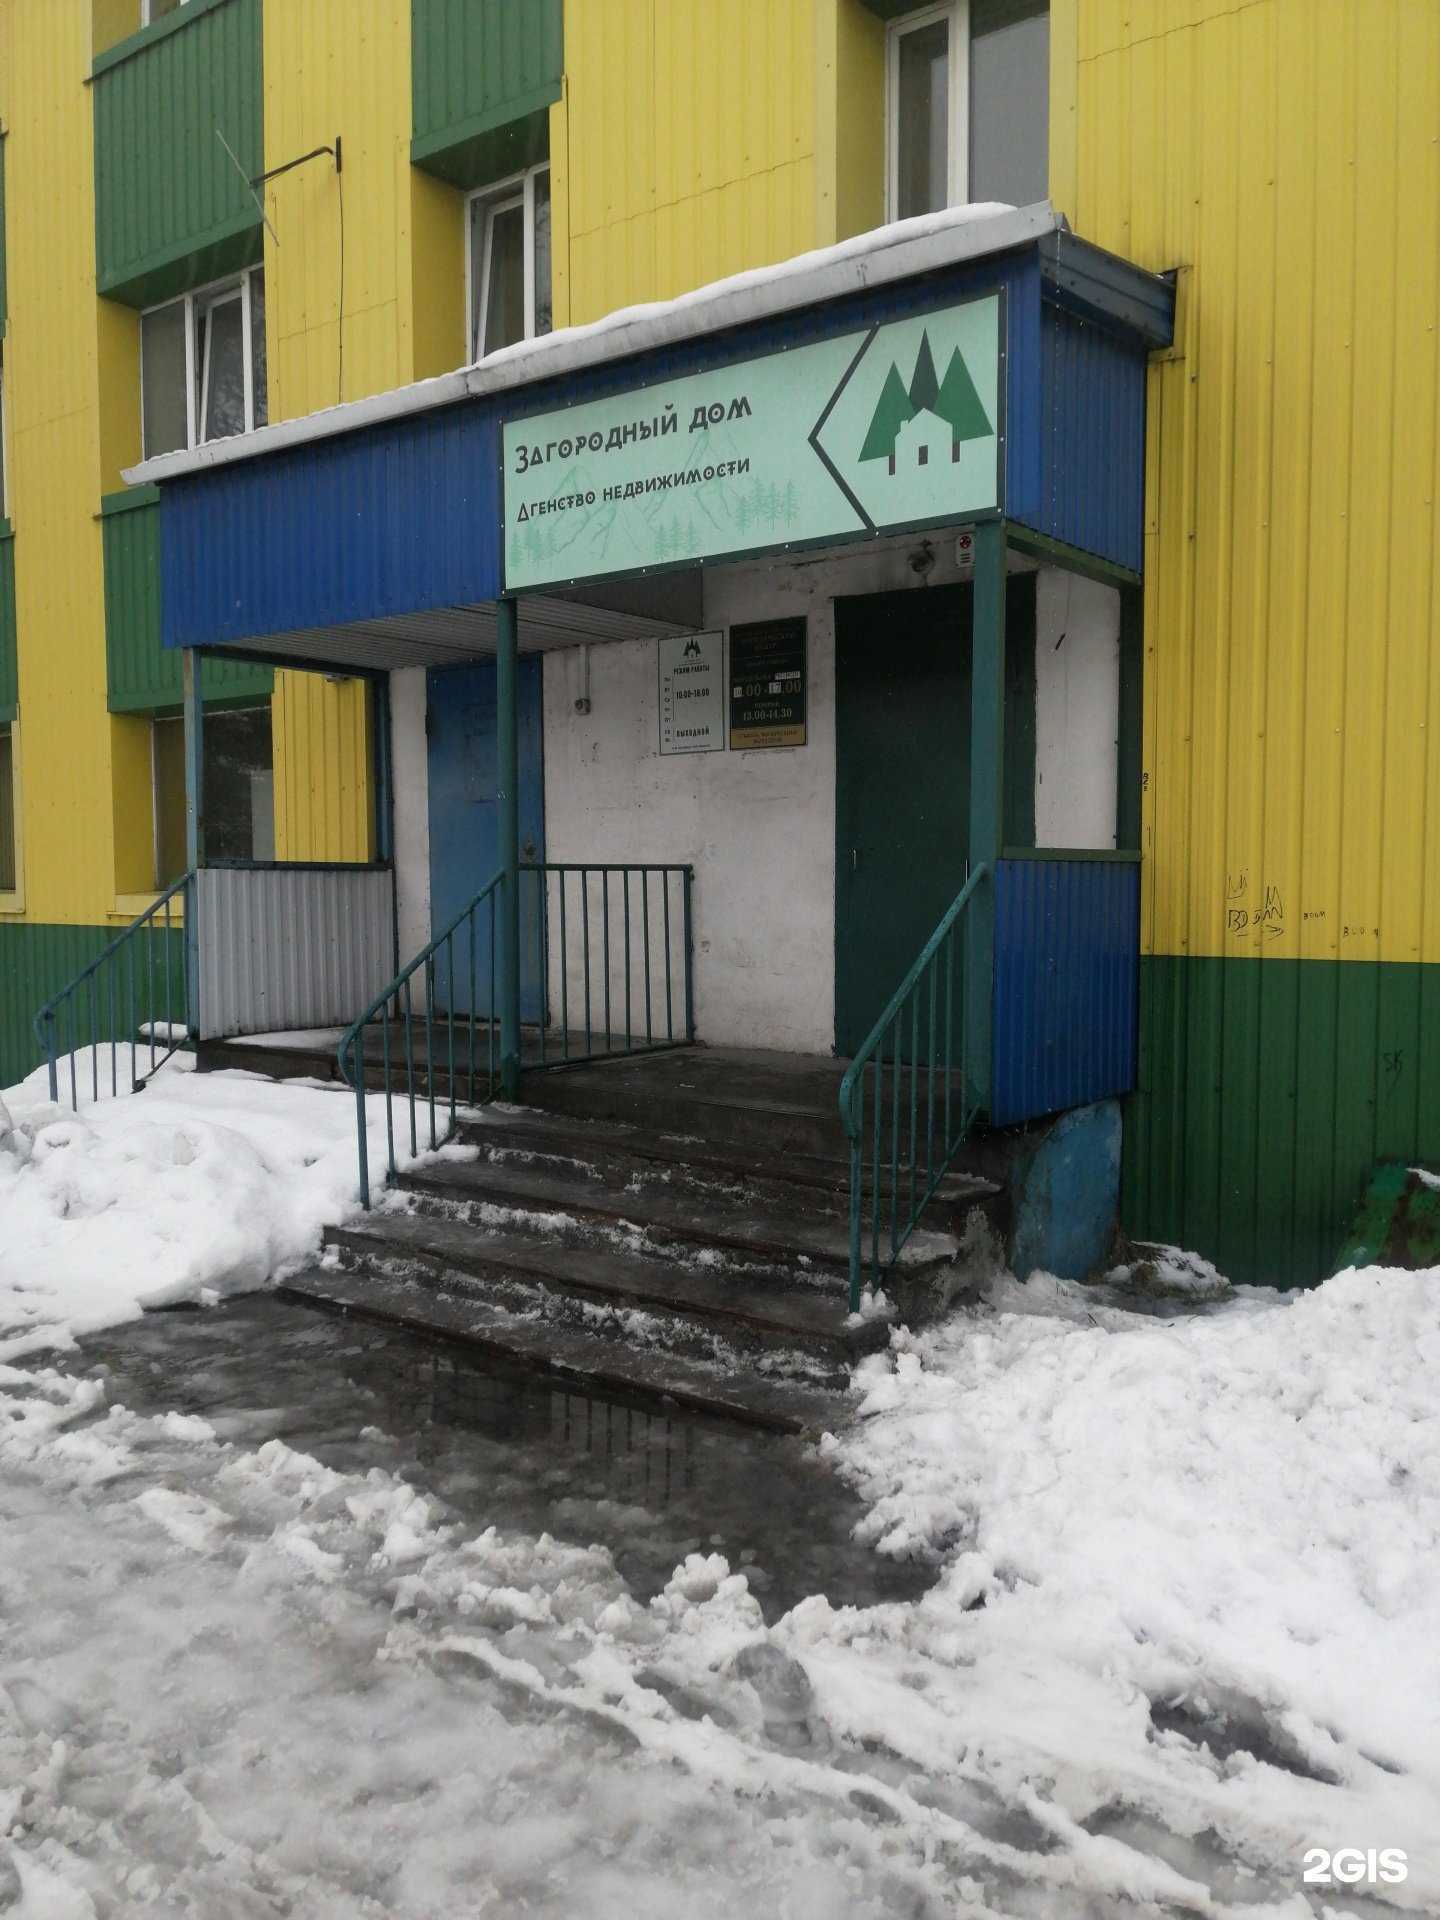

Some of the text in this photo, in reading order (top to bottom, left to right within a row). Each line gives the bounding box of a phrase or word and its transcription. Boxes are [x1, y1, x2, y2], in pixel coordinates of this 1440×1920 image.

[515, 396, 752, 474] ЗАГОРОДНЫЙ ДОМ
[517, 458, 751, 522] АГЕНСТВО НЕДВИЖИМОСТИ
[676, 726, 710, 738] ВЫХОДНОЙ
